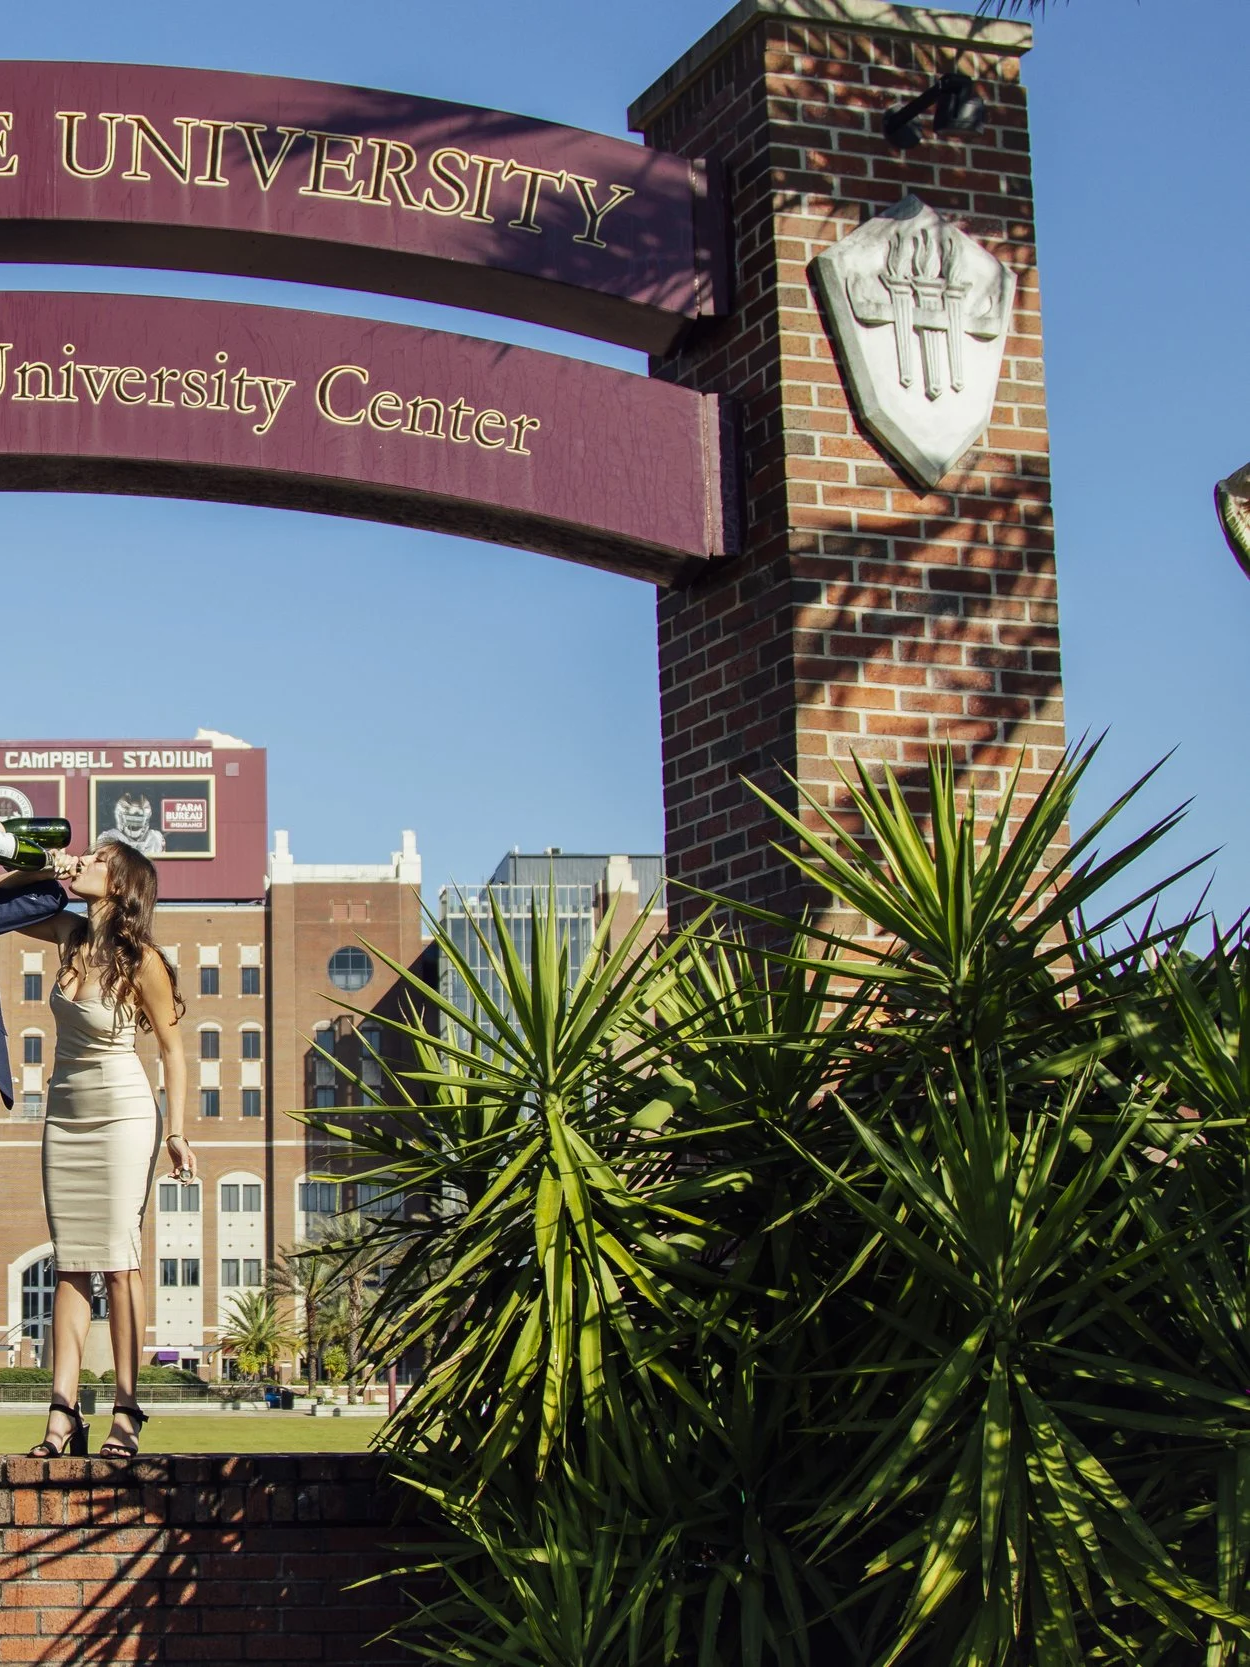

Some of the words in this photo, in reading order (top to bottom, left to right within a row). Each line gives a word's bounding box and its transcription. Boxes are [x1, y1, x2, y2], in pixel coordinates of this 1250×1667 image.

[55, 111, 635, 248] UNIVERSITY
[315, 364, 541, 455] Center
[4, 751, 113, 768] CAMPBELL
[123, 751, 213, 768] STADIUM
[165, 811, 203, 820] BUREAU
[176, 802, 203, 812] FARM
